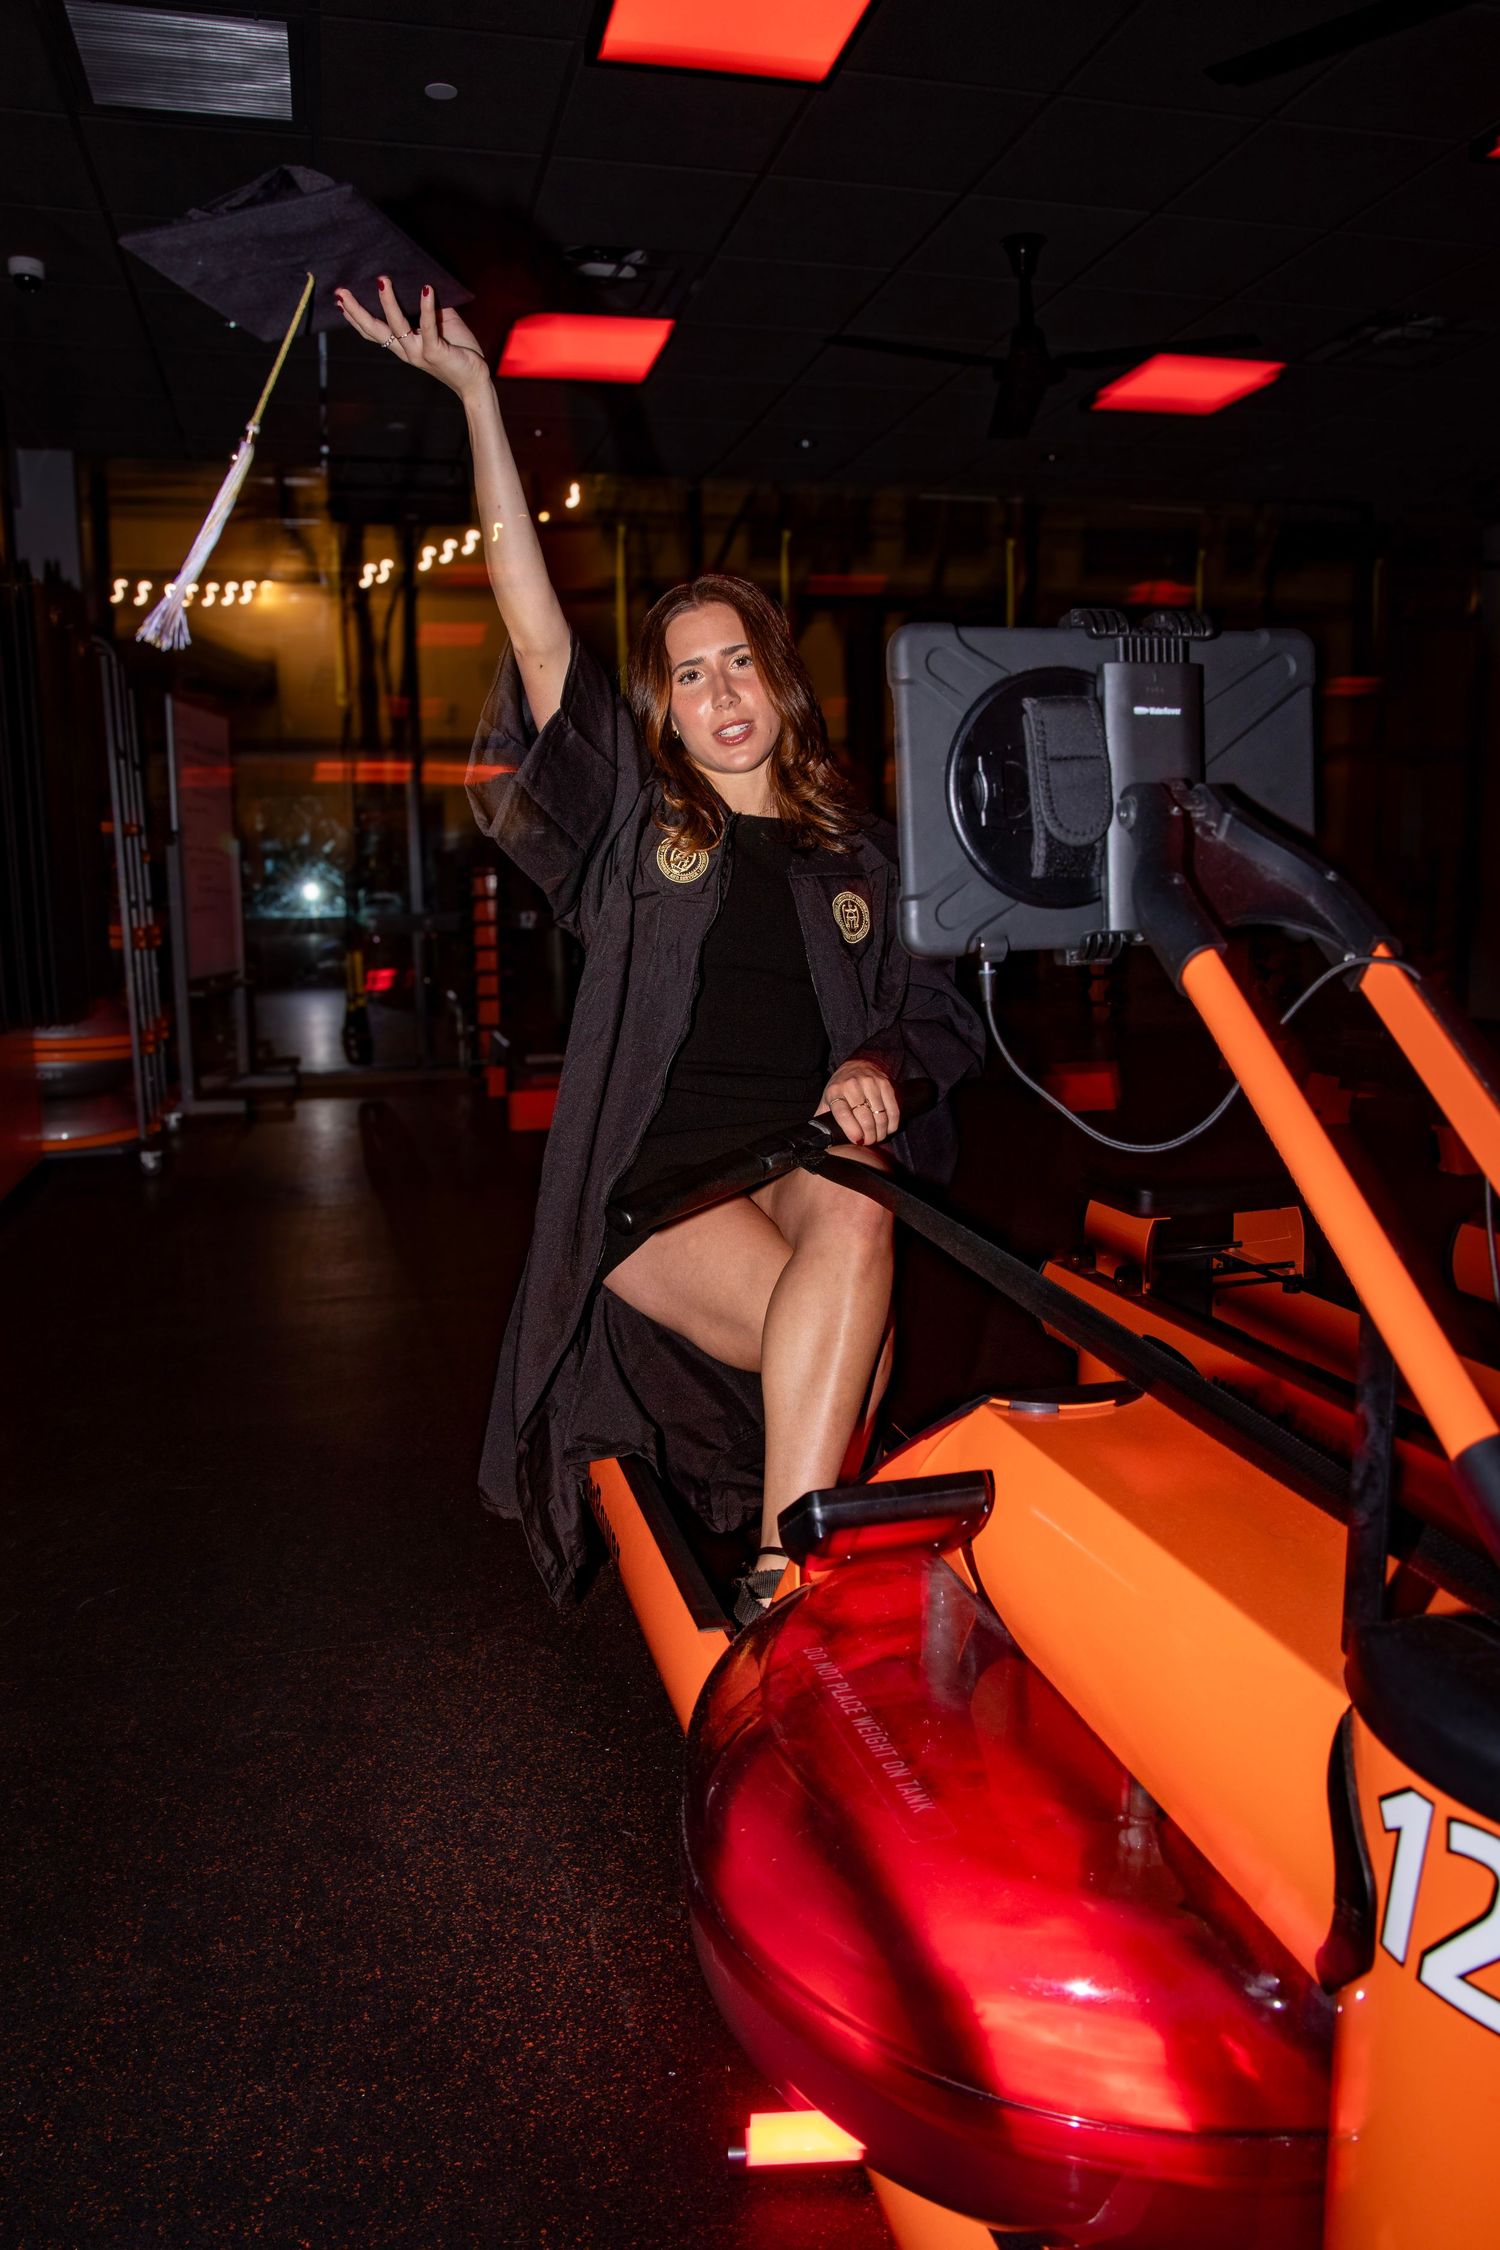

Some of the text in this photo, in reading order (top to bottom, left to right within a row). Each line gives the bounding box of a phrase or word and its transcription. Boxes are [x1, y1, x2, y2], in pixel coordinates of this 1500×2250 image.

[803, 1646, 936, 1813] DO NOT PLACE WEIGHT ON TANK
[1378, 1786, 1500, 2037] 12
